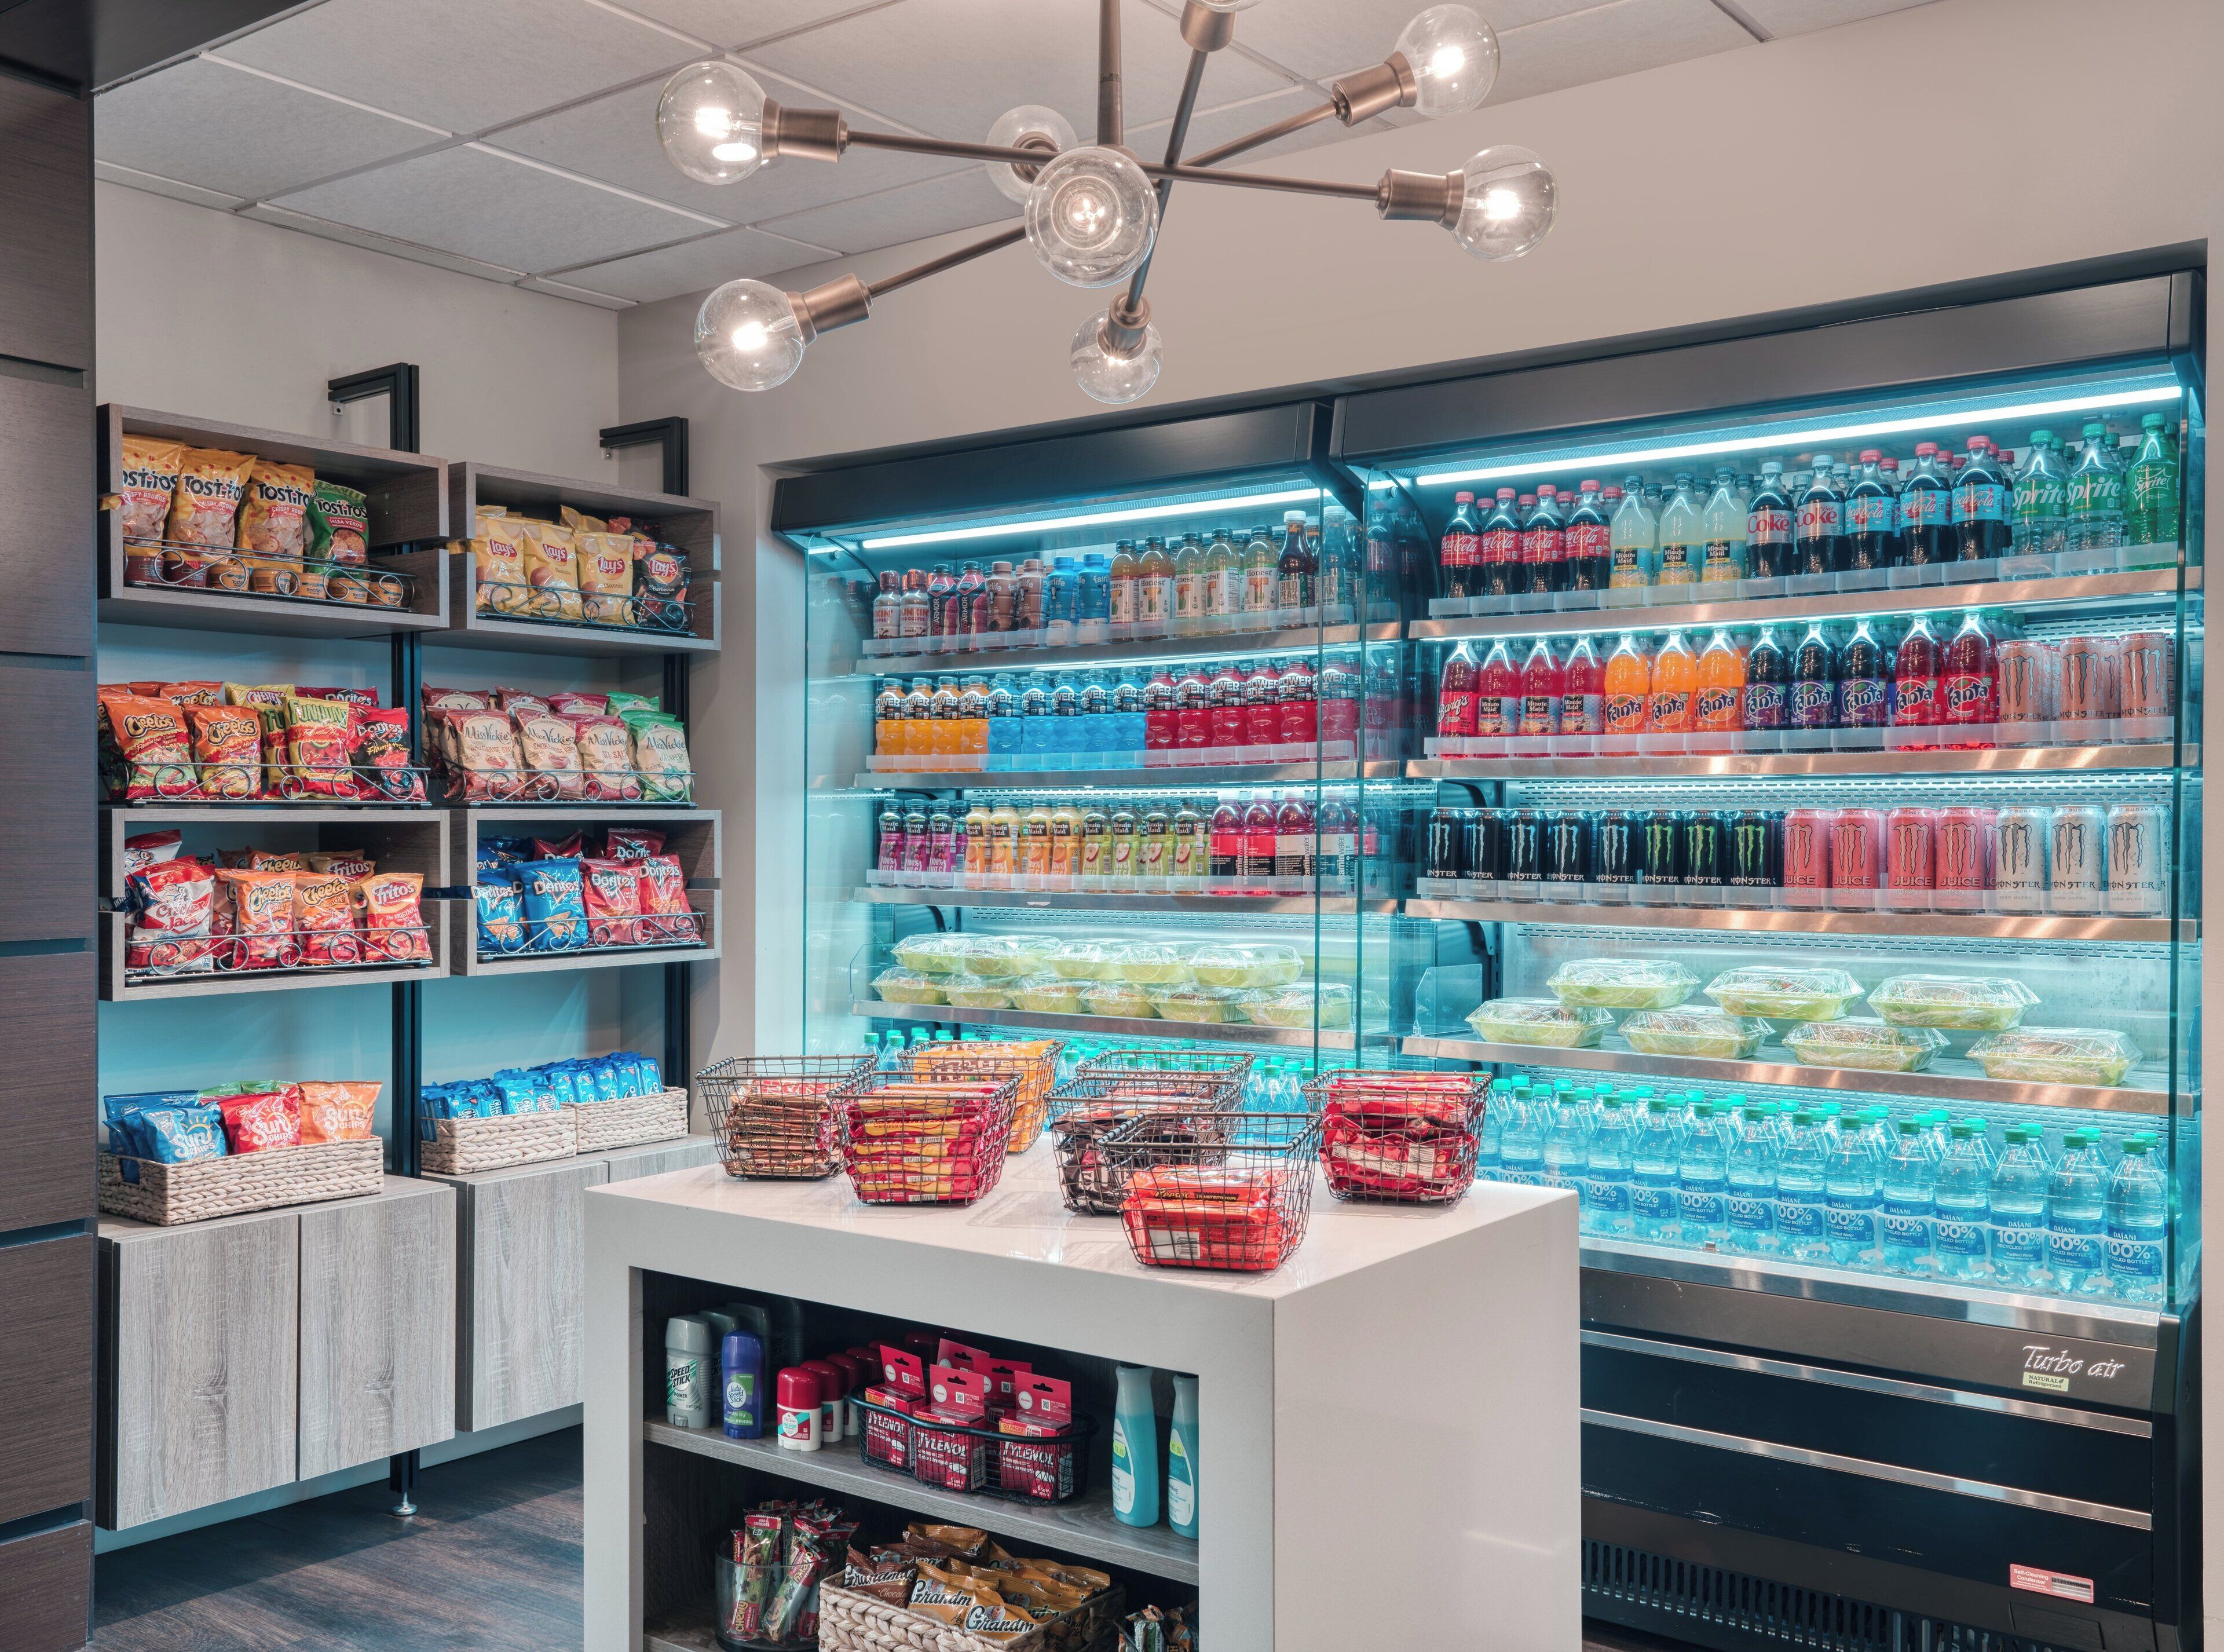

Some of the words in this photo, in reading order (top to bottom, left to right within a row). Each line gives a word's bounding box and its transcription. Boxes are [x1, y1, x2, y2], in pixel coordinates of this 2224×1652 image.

[2136, 476, 2167, 491] Sprite
[144, 493, 166, 503] ROUNDS
[2013, 483, 2066, 511] Sprite
[2066, 477, 2121, 507] Sprite
[346, 520, 363, 528] VERDE
[1747, 514, 1790, 534] Coke
[1797, 508, 1838, 527] Coke
[1707, 545, 1728, 554] Minute
[555, 567, 571, 576] Classic
[599, 557, 623, 573] Lay's
[650, 560, 677, 578] Lay's
[1246, 569, 1273, 577] Honest
[1279, 580, 1297, 593] GOLD
[1280, 591, 1298, 600] PEAK
[1280, 675, 1311, 685] POWER
[1745, 688, 1783, 715] Fanta
[1793, 687, 1832, 715] Fanta
[1842, 685, 1884, 712] Fanta
[1896, 685, 1934, 712] Fanta
[1947, 682, 1989, 711] Fanta
[1438, 696, 1468, 723] Barq's
[1606, 699, 1643, 724] Fanta
[1652, 699, 1685, 723] Fanta
[1698, 693, 1735, 718] Fanta
[124, 714, 176, 738] Cheetos
[207, 719, 257, 745] Cheetos
[357, 722, 403, 736] Doritos
[639, 865, 680, 878] Doritos
[591, 873, 635, 887] Doritos
[1596, 875, 1634, 883] MONSTER
[1684, 875, 1722, 884] MONSTER
[1834, 876, 1871, 886] JUICE
[1893, 876, 1932, 886] JUICE
[1941, 876, 1980, 887] JUICE
[373, 883, 416, 906] Fritos
[324, 1108, 365, 1130] Sun
[338, 1119, 365, 1130] CHIPS
[251, 1121, 290, 1145] Sun
[174, 1132, 211, 1158] Sun
[1155, 1187, 1190, 1198] Reese's
[1681, 1194, 1715, 1208] 100%
[1729, 1199, 1764, 1215] 100%
[1778, 1205, 1812, 1221] 100%
[1826, 1211, 1864, 1226] 100%
[1942, 1214, 1963, 1222] DASANI
[1884, 1218, 1923, 1232] 100%
[1937, 1223, 1976, 1238] 100%
[2054, 1226, 2076, 1234] DASANI
[1997, 1231, 2041, 1245] 100%
[2049, 1235, 2090, 1251] 100%
[2113, 1232, 2137, 1241] DASANI
[2108, 1242, 2150, 1259] 100%
[2022, 1346, 2083, 1374] Turbo
[2087, 1359, 2124, 1379] air
[670, 1365, 690, 1379] SPEED
[672, 1373, 690, 1388] STICK
[2028, 1380, 2062, 1388] Refrigerant
[2029, 1375, 2058, 1384] NATURAL
[728, 1390, 744, 1401] Speed
[730, 1385, 741, 1393] lady
[869, 1409, 906, 1435] TYLENOL
[1009, 1424, 1024, 1432] PACKS
[917, 1432, 967, 1458] TYLENOL
[1003, 1441, 1054, 1467] TYLENOL
[929, 1457, 948, 1466] Strength
[1015, 1464, 1034, 1474] Strength
[2014, 1569, 2049, 1581] Self-Cleaning
[2017, 1575, 2046, 1585] Condenser
[735, 1600, 749, 1633] CHEWY
